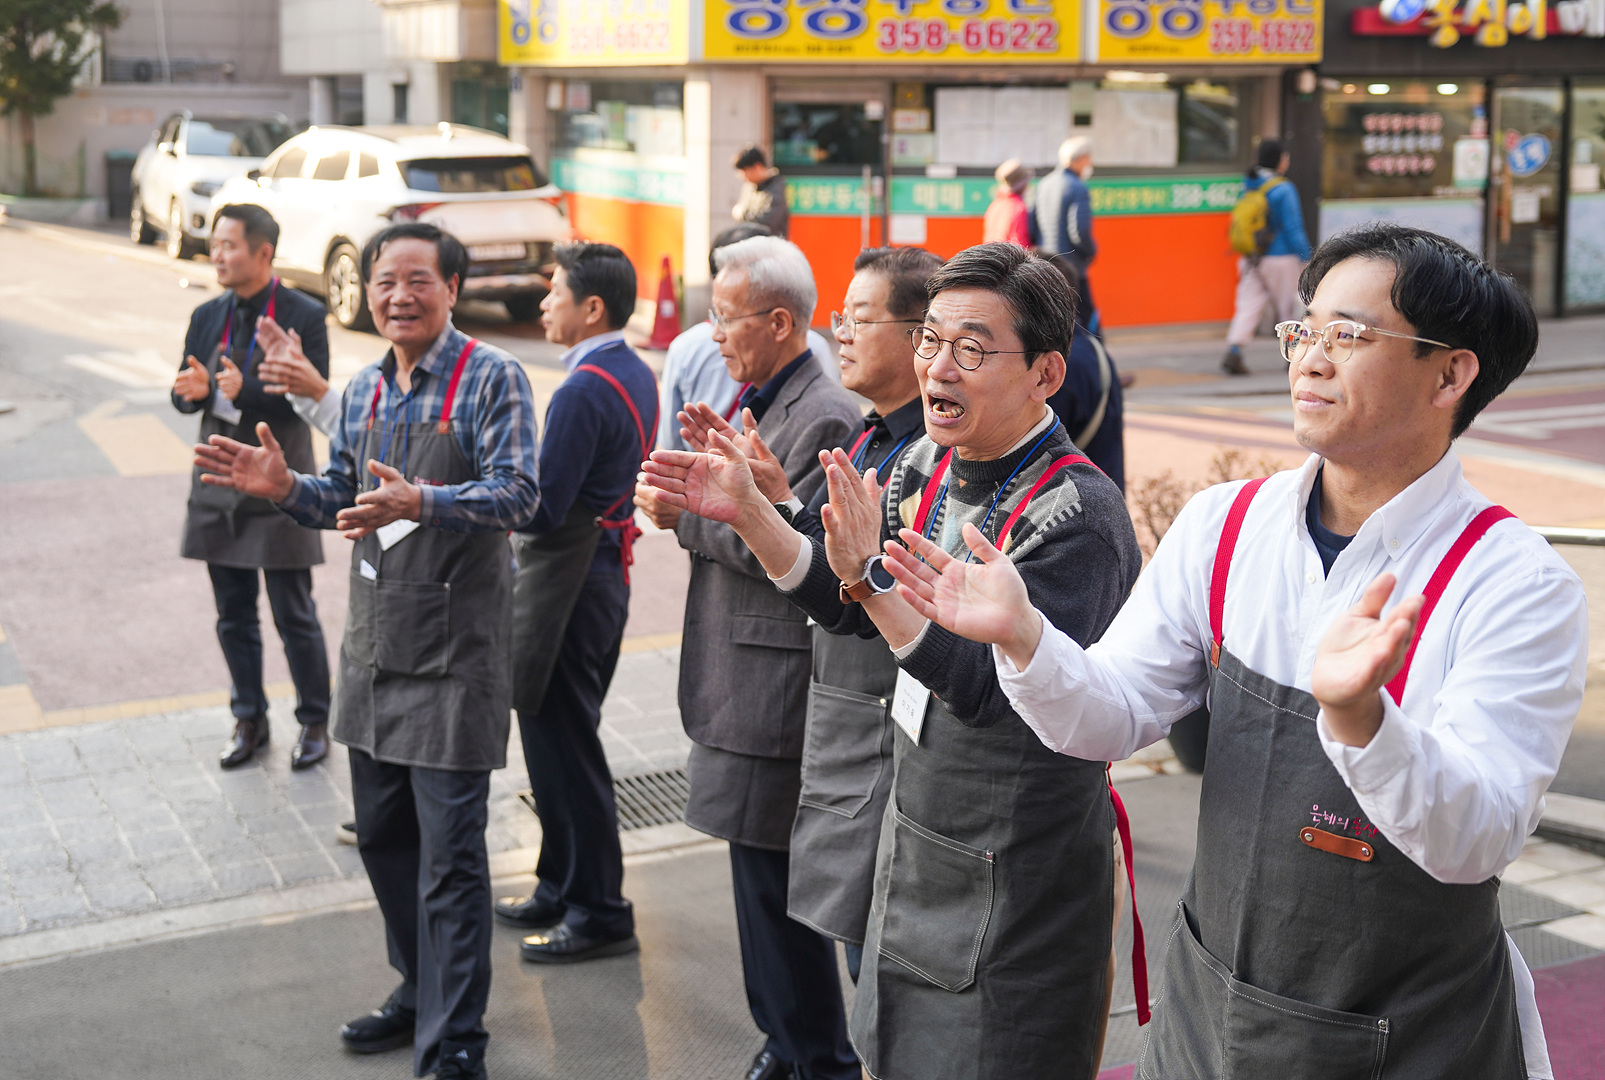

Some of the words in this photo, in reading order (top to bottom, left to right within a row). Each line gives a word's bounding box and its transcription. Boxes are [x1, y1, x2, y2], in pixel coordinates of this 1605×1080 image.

[876, 17, 1059, 53] 358-6622
[1208, 17, 1316, 54] 358-6622
[1309, 804, 1349, 829] 은혜의
[1351, 817, 1380, 838] 동산
